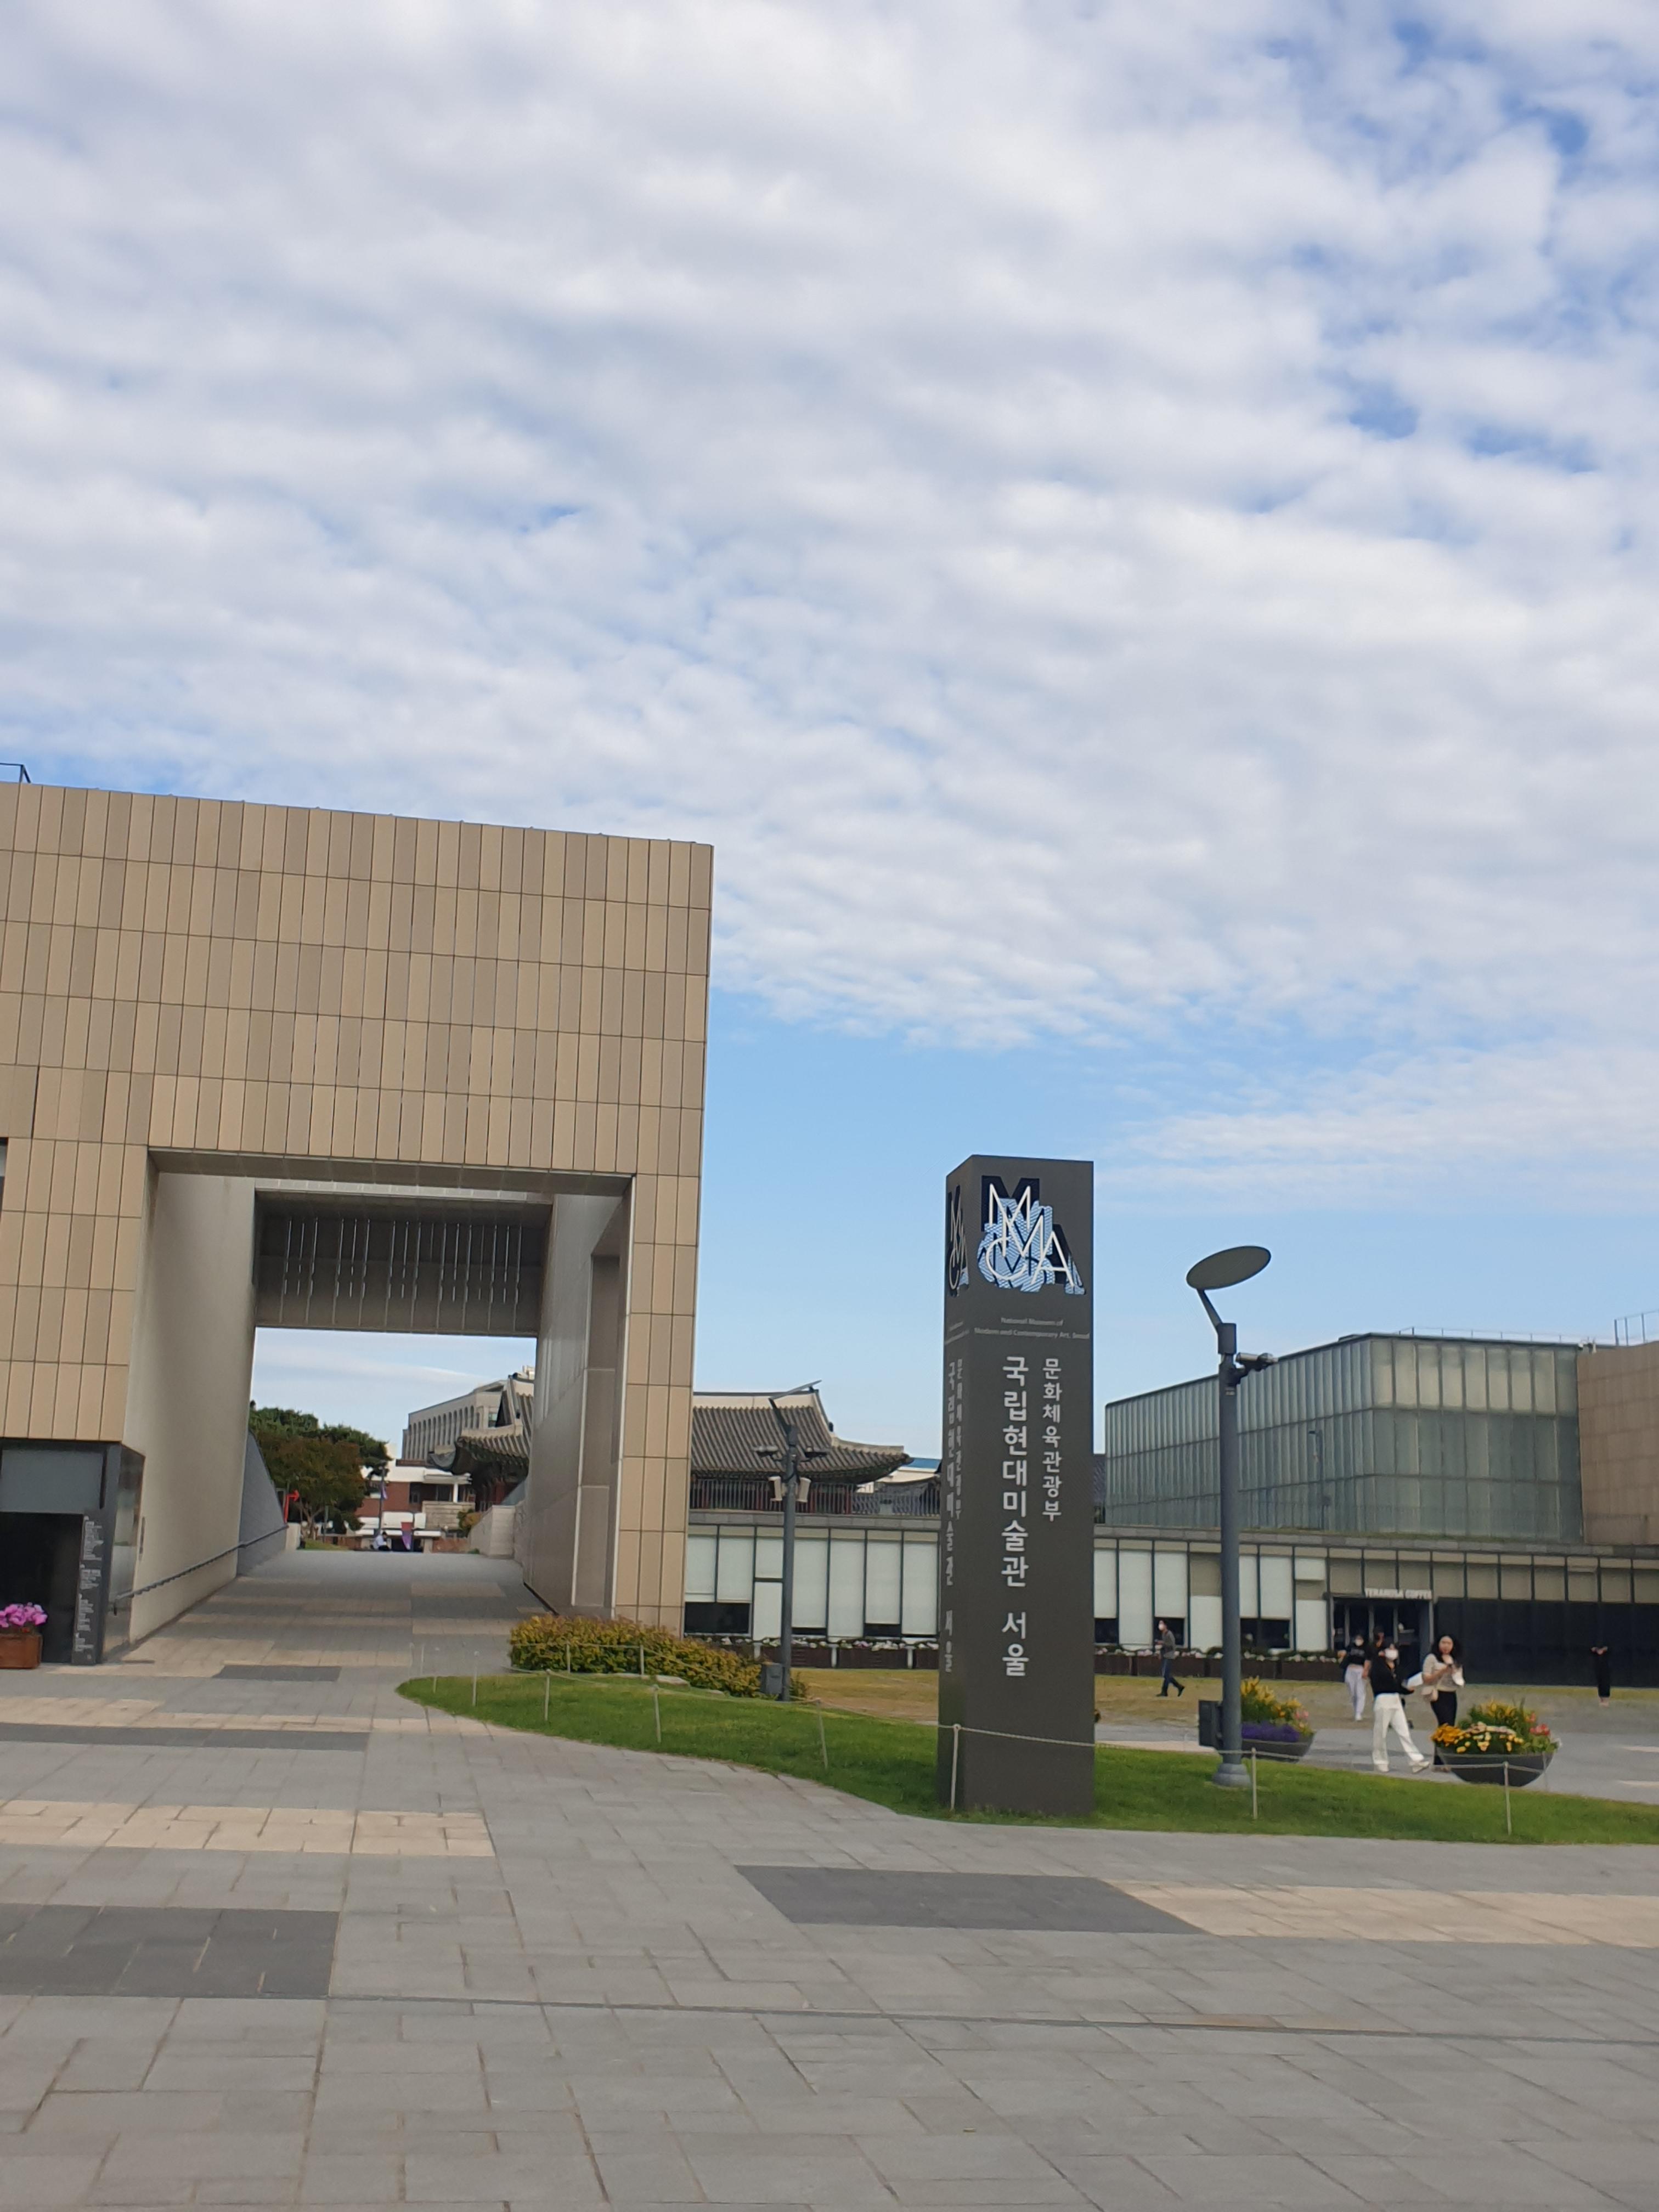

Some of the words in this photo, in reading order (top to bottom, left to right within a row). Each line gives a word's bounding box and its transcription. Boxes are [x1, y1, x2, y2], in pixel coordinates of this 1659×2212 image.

[1001, 1356, 1029, 1587] 국립현대미술관
[1042, 1358, 1062, 1522] 문화체육관광부
[1001, 1612, 1029, 1677] 서울
